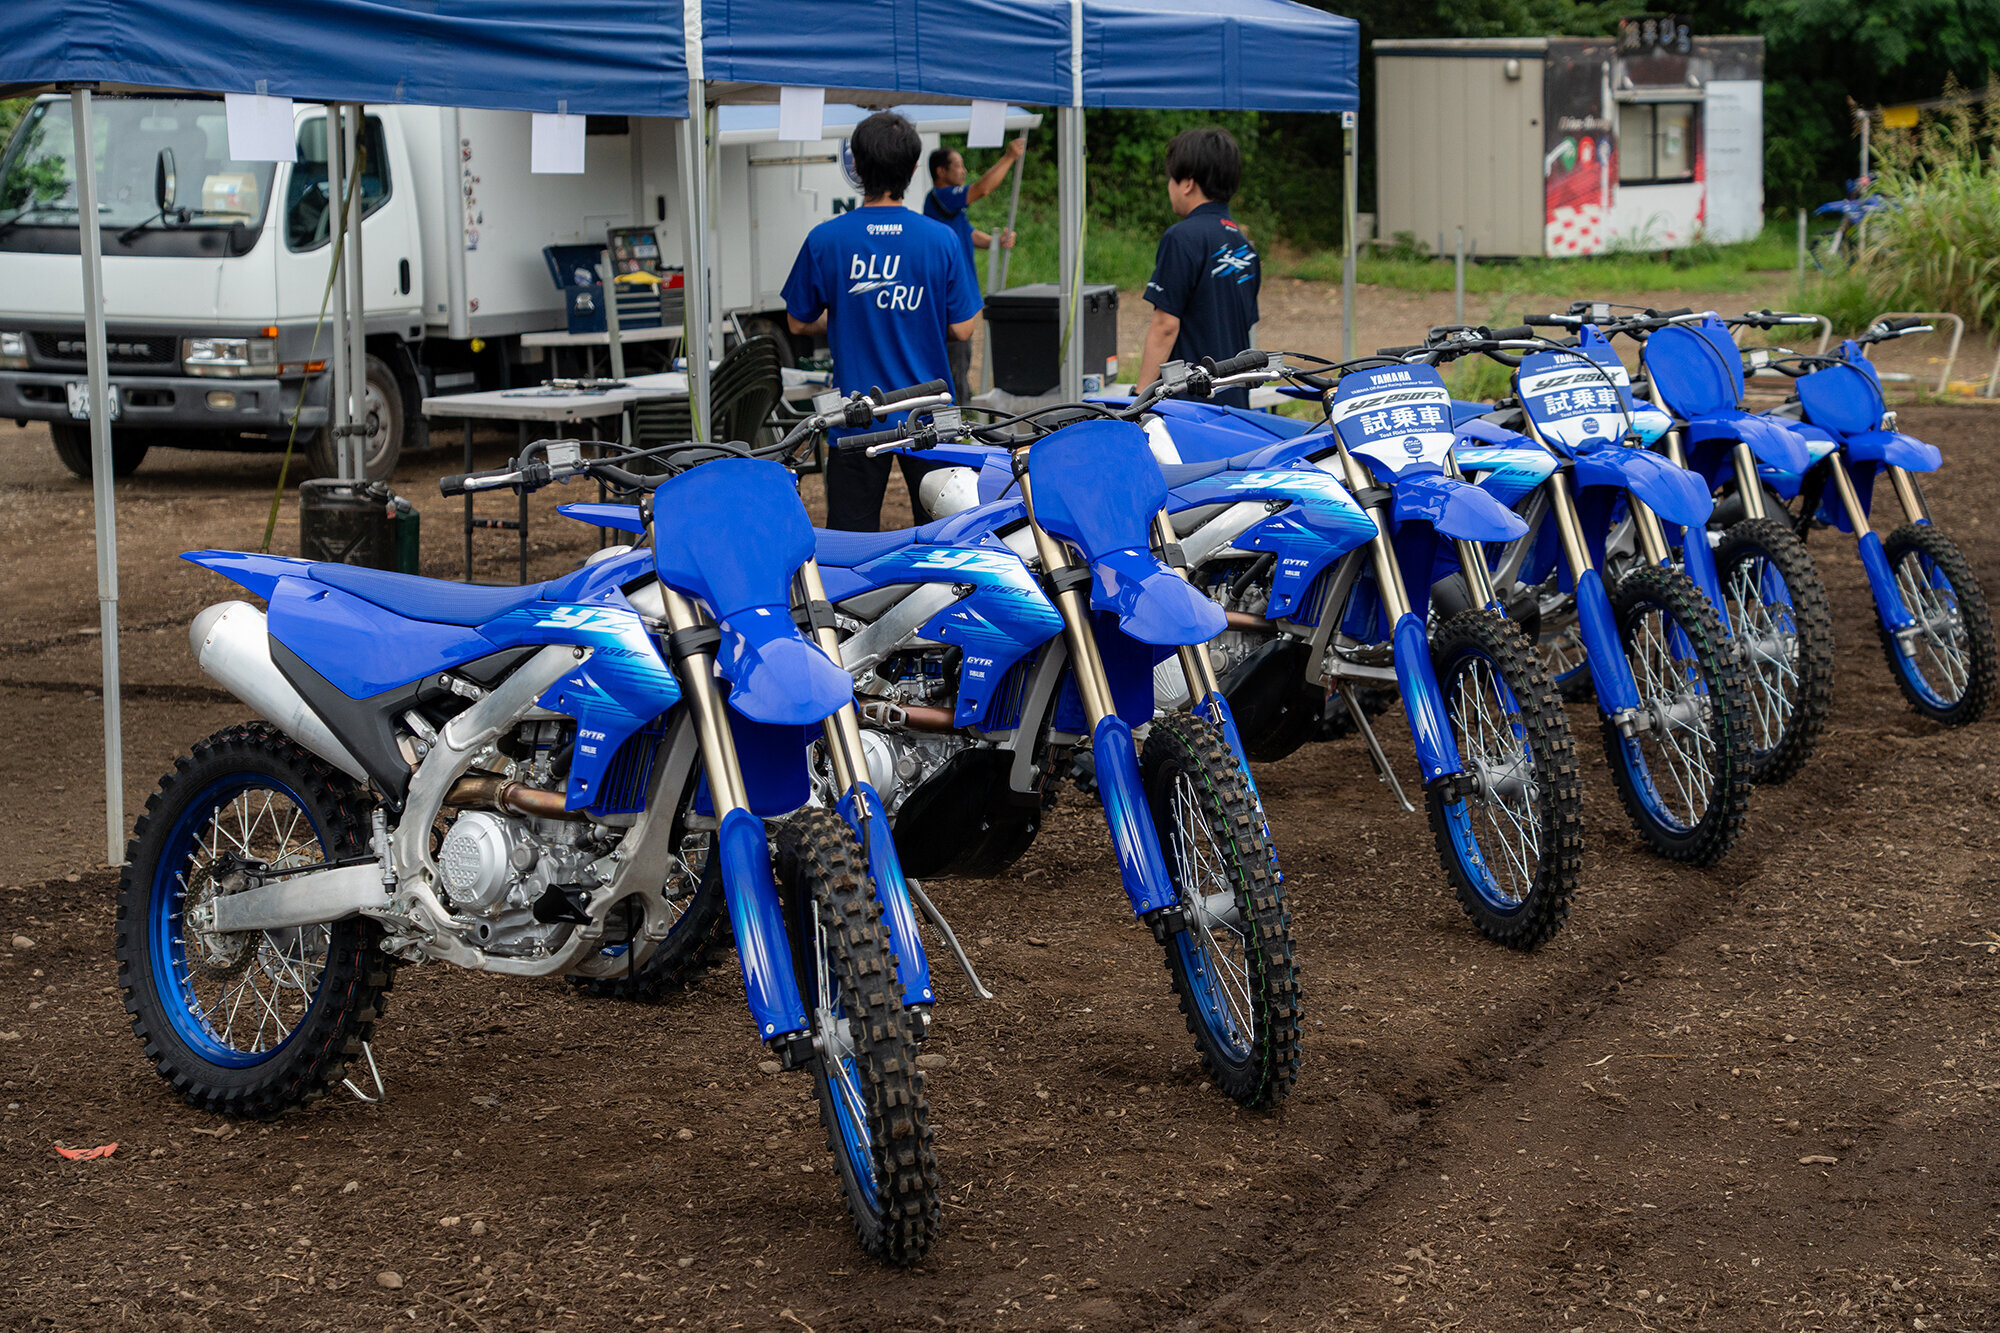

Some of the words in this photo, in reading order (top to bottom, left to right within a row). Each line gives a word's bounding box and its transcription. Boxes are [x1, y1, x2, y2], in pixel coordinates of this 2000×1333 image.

[875, 224, 903, 232] YAMAHA
[849, 253, 901, 280] bLU
[876, 285, 924, 311] cRU
[1370, 371, 1412, 385] YAMAHA
[1544, 387, 1619, 416] 試乗車
[1360, 405, 1445, 436] 試乗車
[1379, 431, 1393, 439] Test
[1407, 426, 1437, 435] Motorcycle
[1225, 473, 1329, 489] YZ
[909, 549, 1014, 574] YZ
[1282, 558, 1309, 568] GYTR
[532, 606, 632, 634] YZ
[966, 656, 993, 667] GYTR
[578, 728, 606, 742] GYTR
